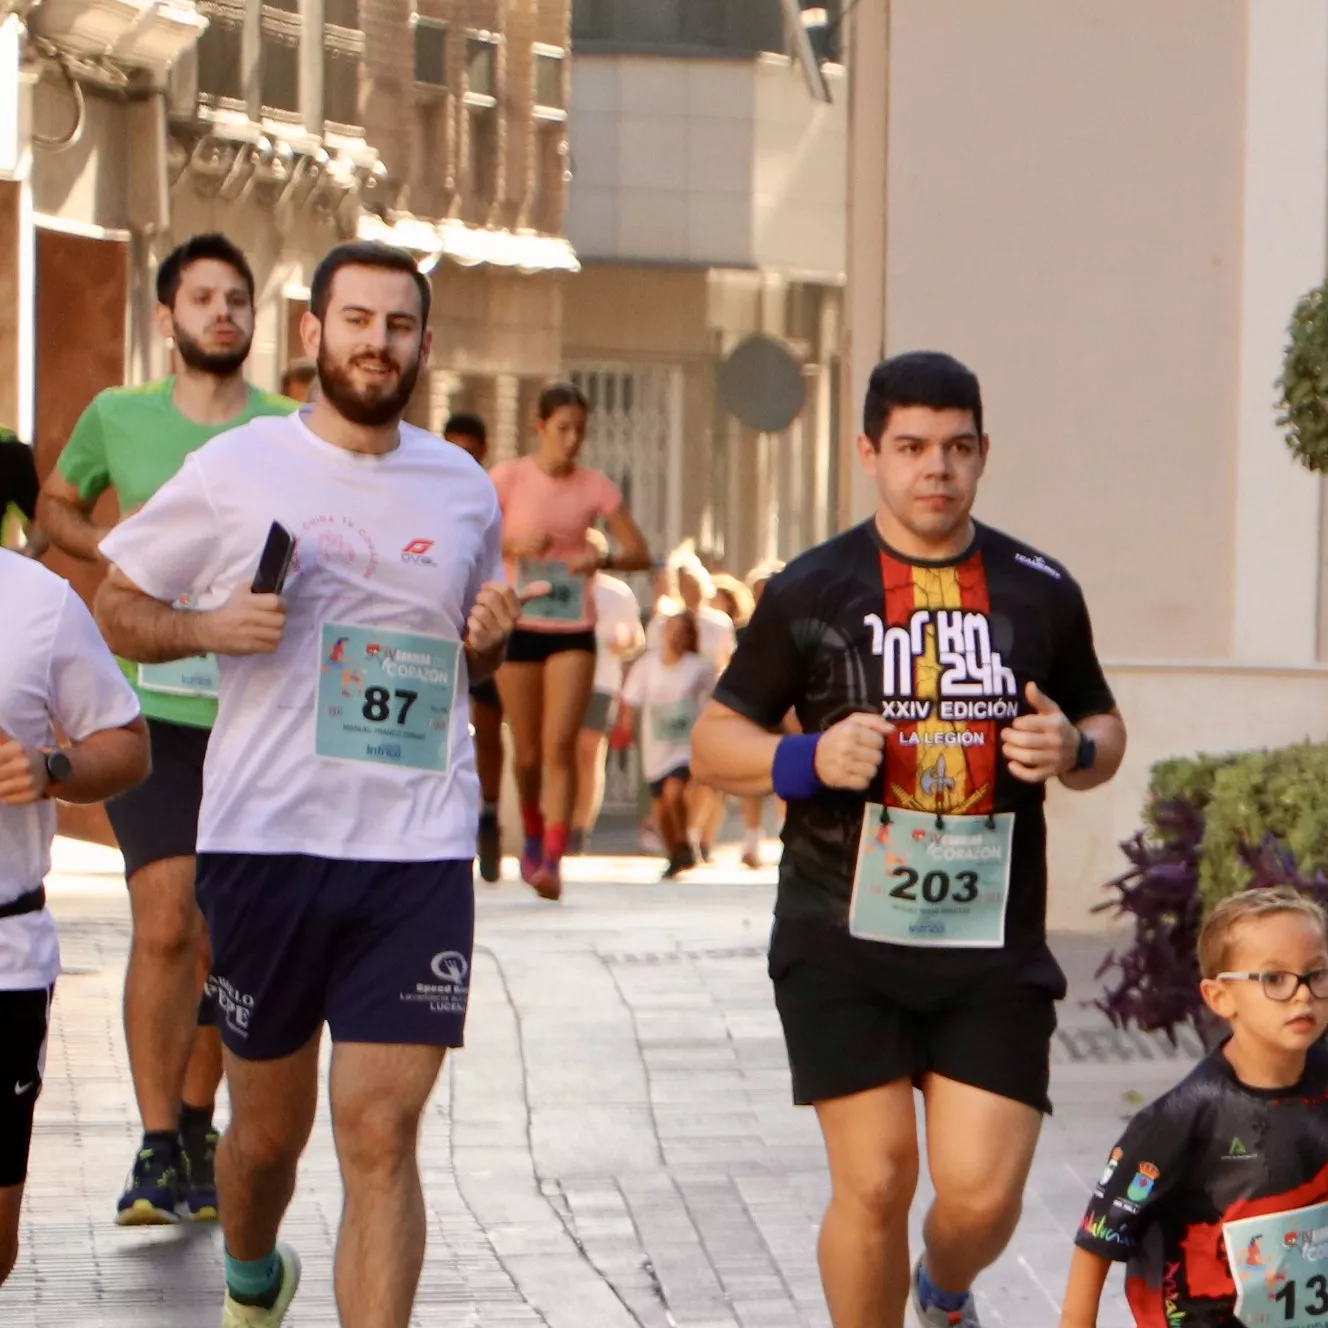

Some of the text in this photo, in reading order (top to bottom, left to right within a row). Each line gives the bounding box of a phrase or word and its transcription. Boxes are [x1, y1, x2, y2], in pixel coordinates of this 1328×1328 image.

[362, 685, 418, 726] 87
[882, 698, 1018, 718] XXIV EDICIÓN
[899, 731, 984, 745] LA LEGIÓN
[888, 865, 979, 904] 203
